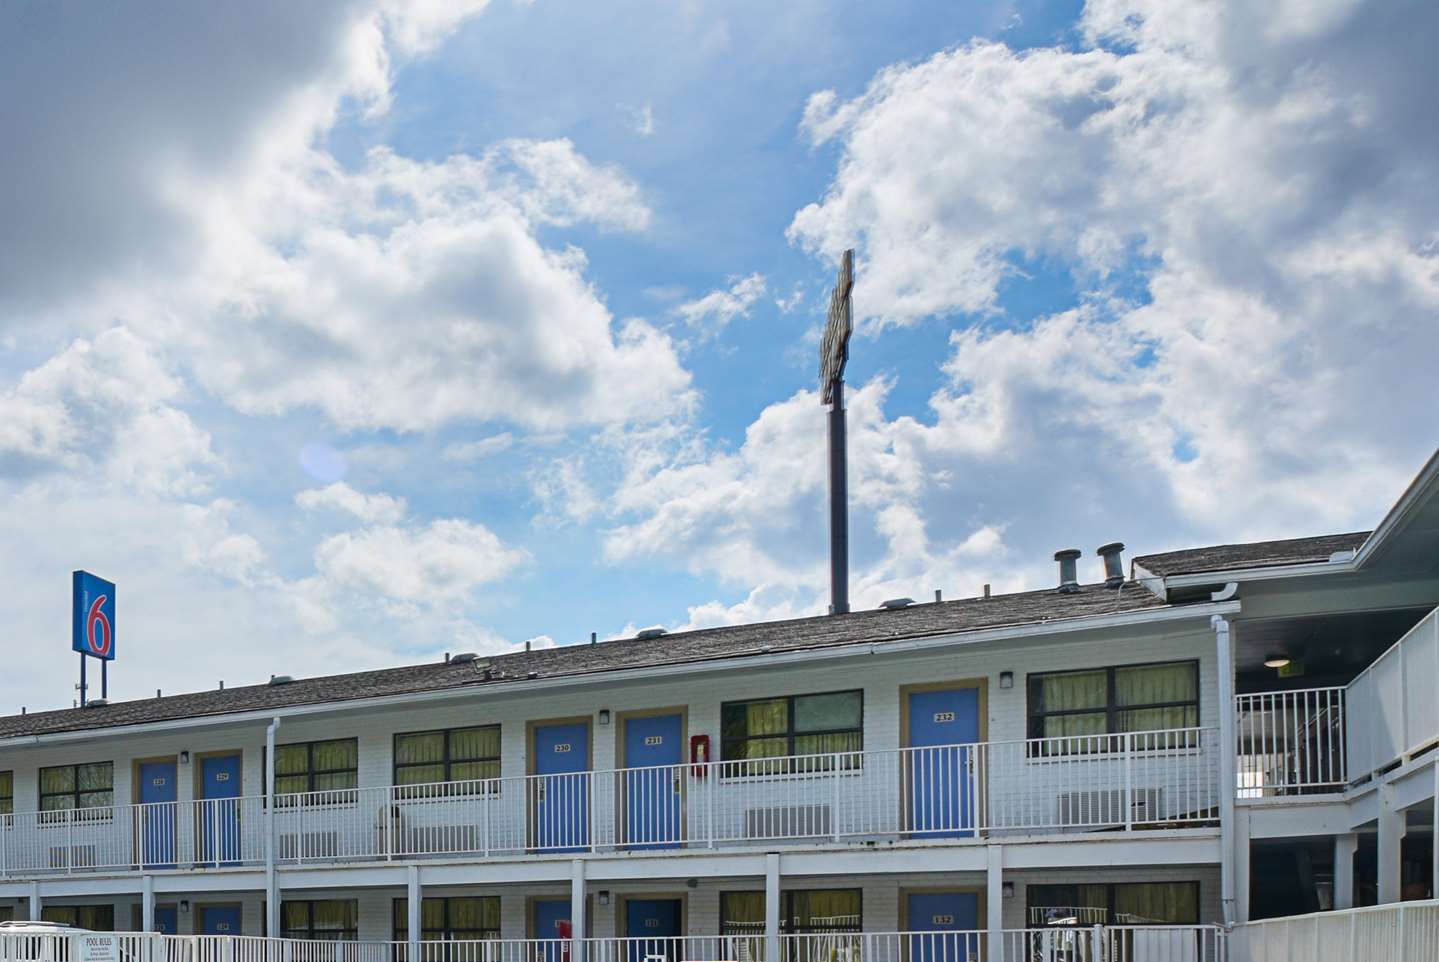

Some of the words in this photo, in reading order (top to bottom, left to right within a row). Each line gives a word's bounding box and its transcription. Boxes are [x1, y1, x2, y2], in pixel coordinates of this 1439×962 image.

[87, 594, 111, 656] 6
[86, 937, 98, 946] POOL
[99, 937, 112, 946] RULES
